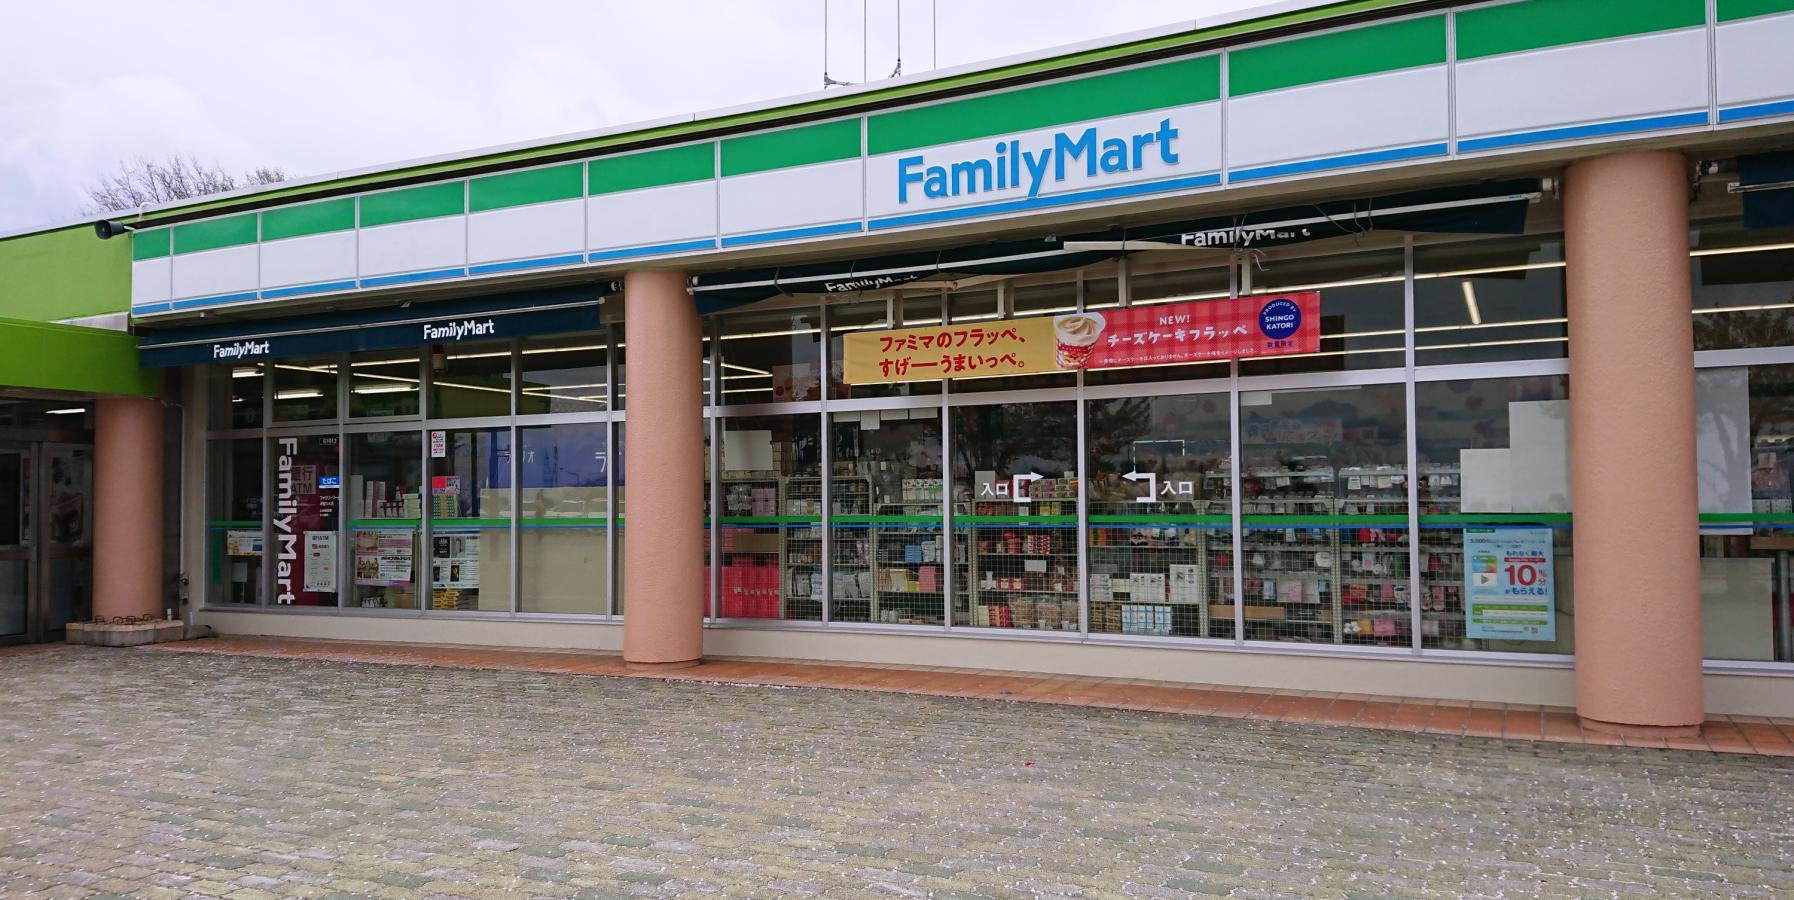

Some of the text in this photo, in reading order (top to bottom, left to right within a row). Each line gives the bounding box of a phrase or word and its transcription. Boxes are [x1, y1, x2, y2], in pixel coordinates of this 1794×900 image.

[898, 118, 1179, 204] FamilyMart
[1263, 301, 1290, 316] PRODUCED
[1159, 315, 1191, 326] NEW!
[1265, 314, 1295, 323] SHINGO
[1266, 322, 1294, 330] KATORI
[423, 319, 495, 340] FamilyMart
[1107, 324, 1248, 347] チーズケーキフラッペ
[879, 327, 1026, 353] ファミマのフラッペ、
[213, 340, 269, 359] FamilyMart
[291, 482, 313, 494] ATM
[322, 477, 337, 485] たばこ
[1160, 480, 1194, 496] 入口
[980, 483, 1009, 496] 入口
[273, 437, 298, 605] FamilyMart
[1504, 564, 1537, 586] 10
